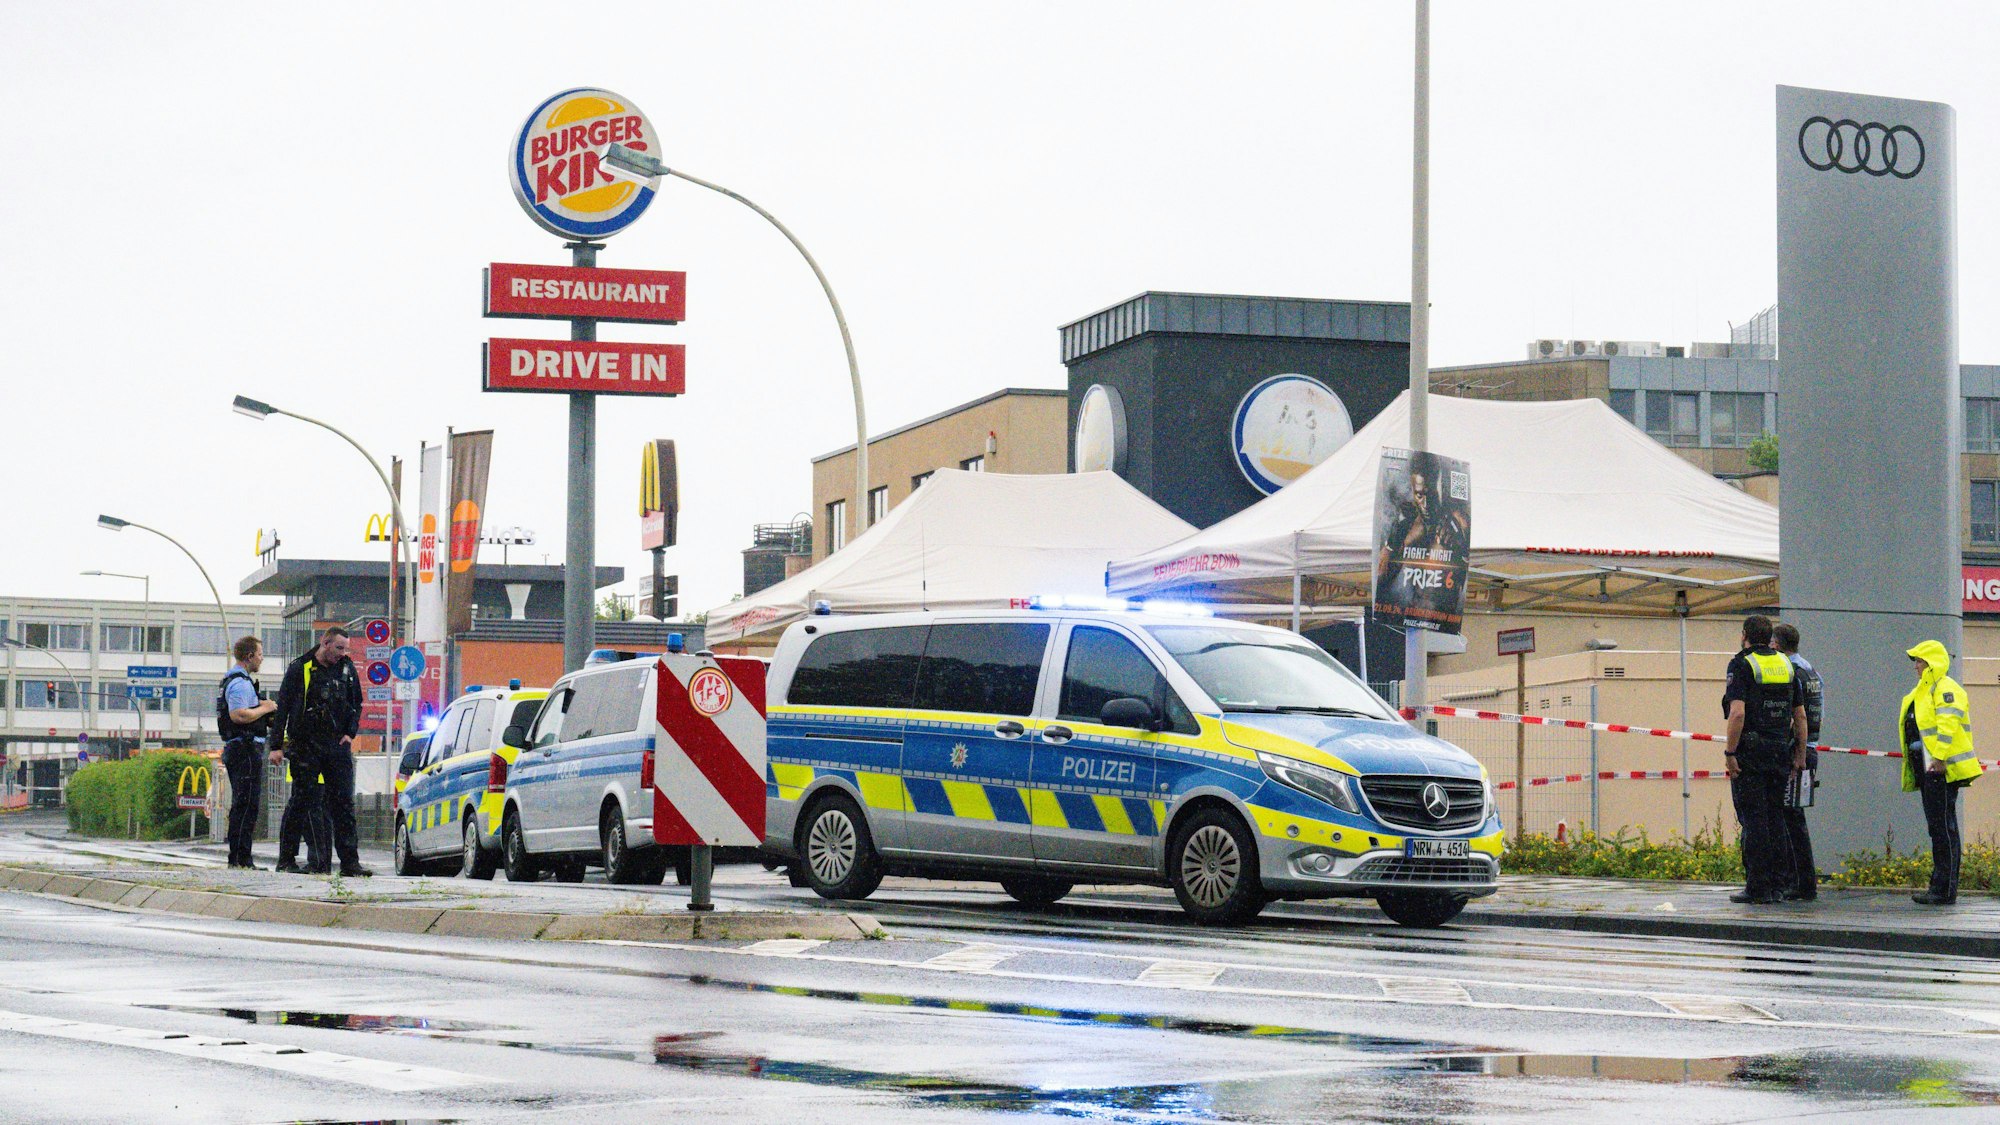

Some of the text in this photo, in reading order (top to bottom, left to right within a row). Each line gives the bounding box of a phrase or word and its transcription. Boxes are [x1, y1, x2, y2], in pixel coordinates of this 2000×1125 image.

[531, 115, 643, 165] BURGER
[535, 141, 648, 205] KIN
[511, 278, 669, 304] RESTAURANT
[510, 349, 667, 381] DRIVE IN
[1153, 553, 1241, 580] FEUERWEHR BONN
[1402, 546, 1453, 562] FIGHT-NIGHT
[1402, 567, 1454, 590] PRIZE 6
[1763, 666, 1787, 677] POLIZEI
[1062, 756, 1136, 784] POLIZEI
[1412, 839, 1432, 856] NRW
